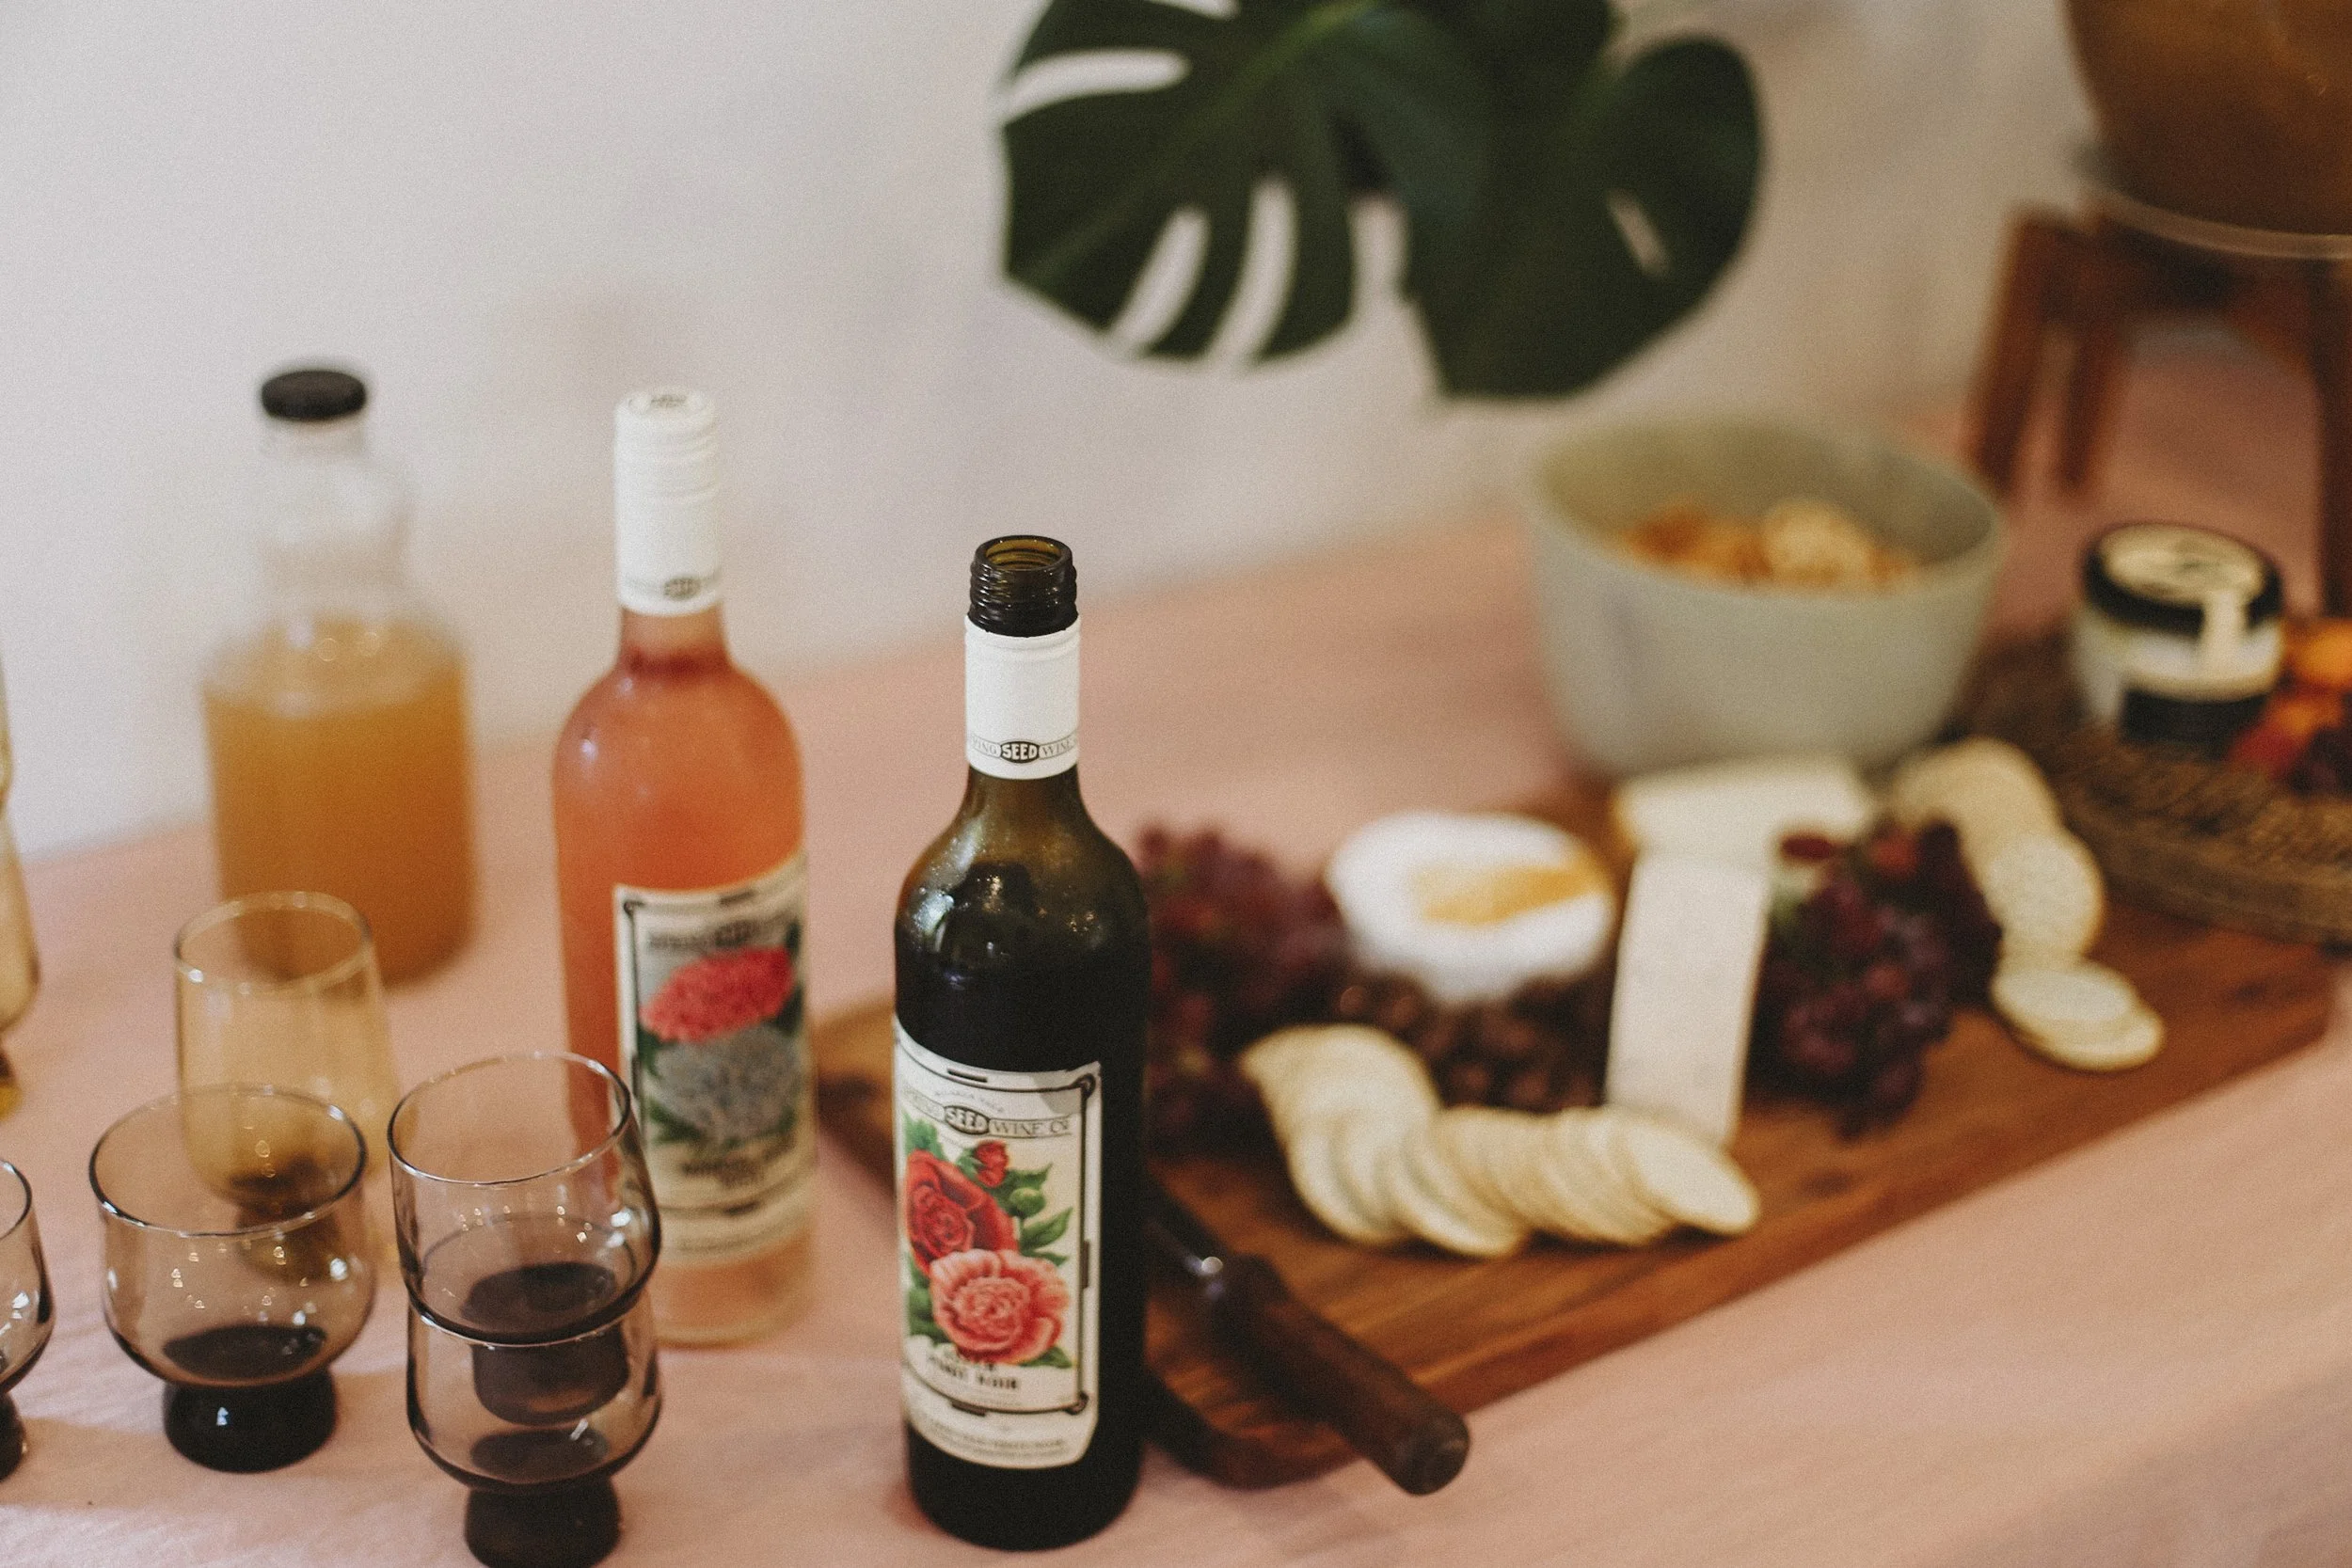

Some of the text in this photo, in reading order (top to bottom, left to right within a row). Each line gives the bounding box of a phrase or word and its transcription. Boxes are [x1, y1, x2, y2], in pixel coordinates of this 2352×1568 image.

[1001, 743, 1039, 760] SEED
[945, 1106, 988, 1132] SEED
[991, 1120, 1044, 1135] WINE
